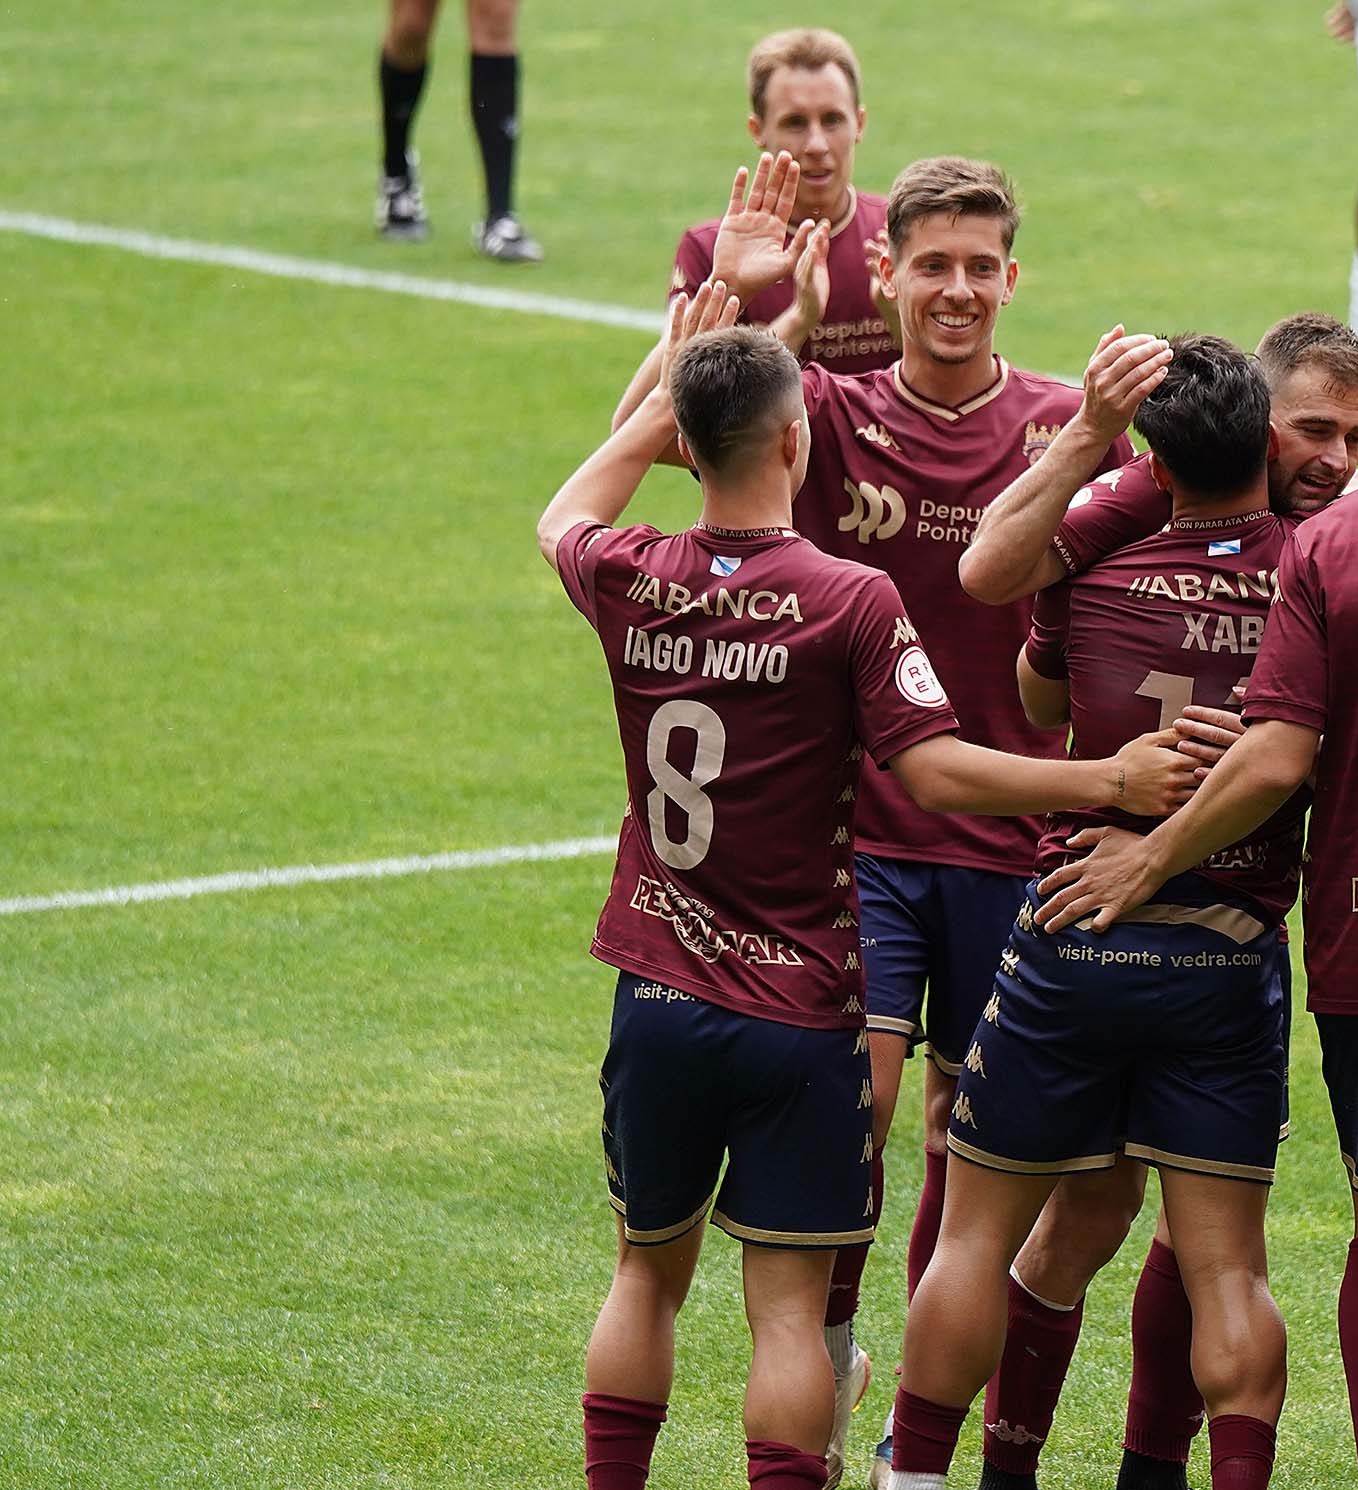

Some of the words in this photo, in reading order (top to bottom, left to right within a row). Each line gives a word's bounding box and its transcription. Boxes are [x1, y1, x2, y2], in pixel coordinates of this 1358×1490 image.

[919, 499, 988, 526] Depu
[1173, 521, 1192, 529] NON
[1194, 520, 1224, 529] PARAR
[1224, 517, 1242, 527] ATA
[746, 528, 780, 537] VOLTAR
[1180, 612, 1265, 654] XAB
[624, 626, 693, 675] IAGO
[702, 638, 790, 684] NOVO
[1134, 669, 1254, 733] 1
[646, 699, 726, 871] 8
[859, 936, 879, 948] CIA
[633, 982, 701, 1005] visit-po
